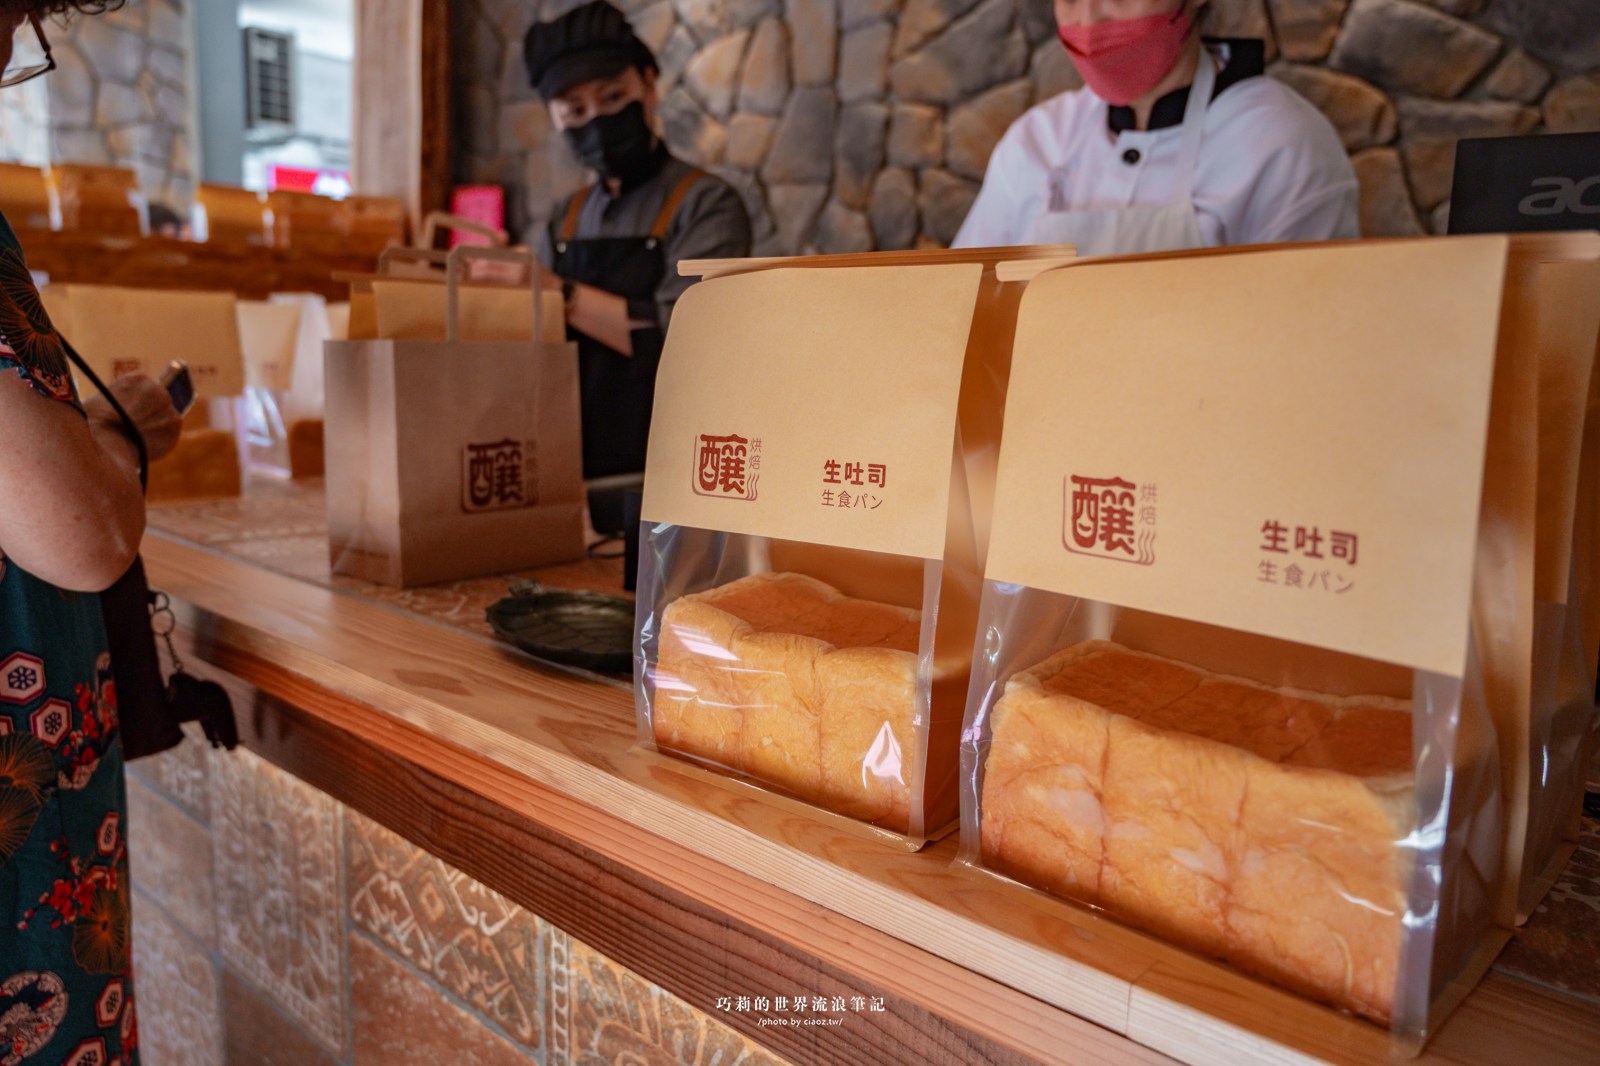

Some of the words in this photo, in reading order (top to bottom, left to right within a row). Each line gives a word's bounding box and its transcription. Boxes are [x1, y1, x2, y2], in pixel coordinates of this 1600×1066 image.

[748, 437, 762, 470] 烘焙
[823, 459, 886, 488] 生吐司
[821, 488, 883, 510] 生食パン
[1139, 482, 1157, 525] 烘焙
[1260, 519, 1358, 566] 生吐司
[1257, 559, 1354, 594] 生食パン
